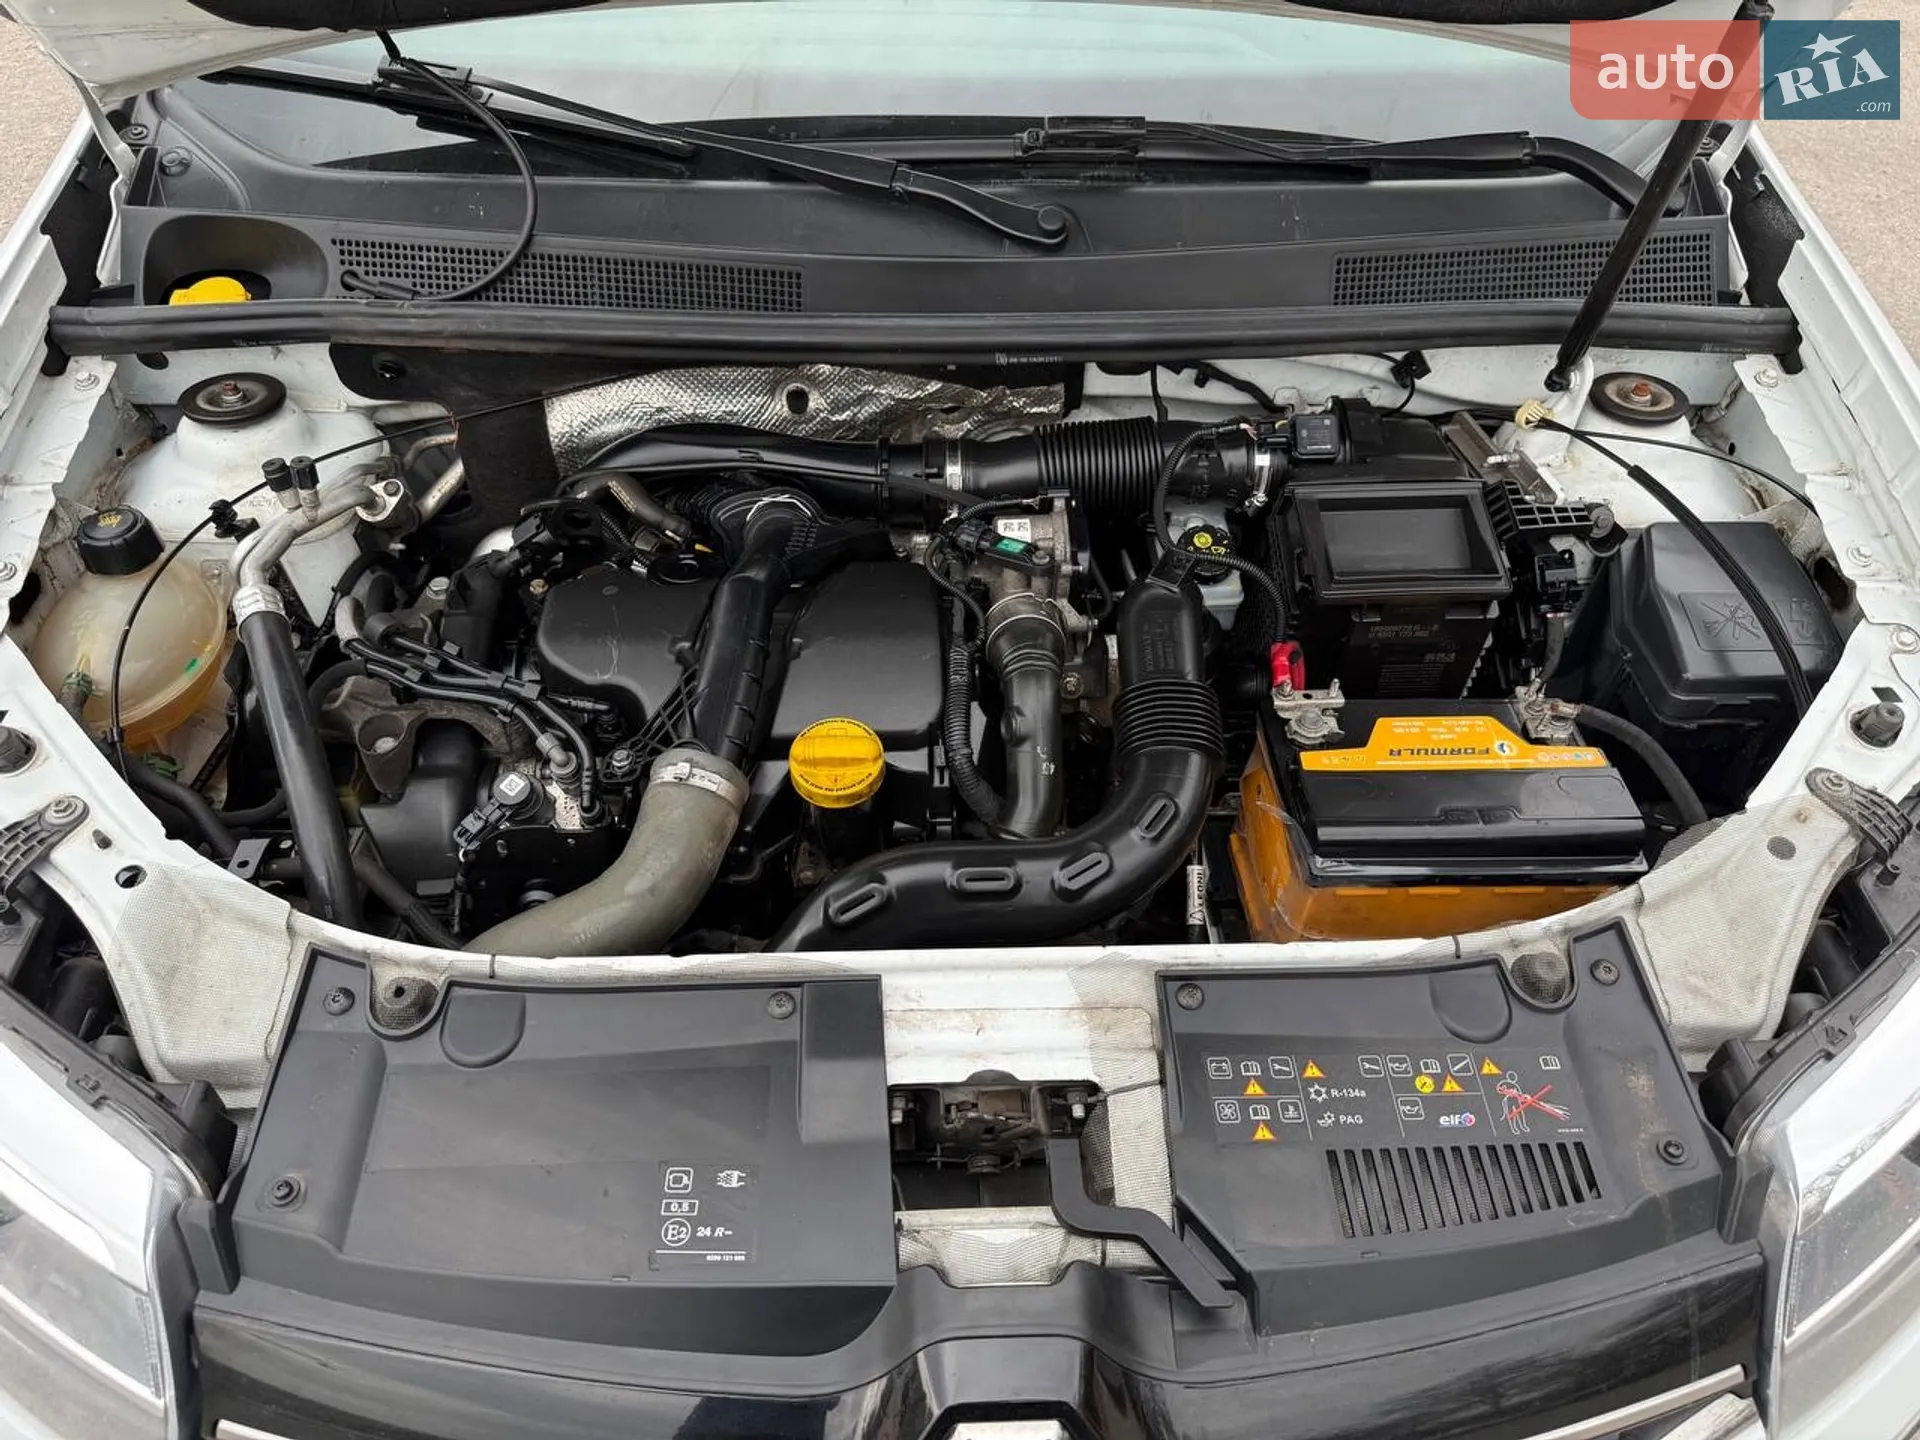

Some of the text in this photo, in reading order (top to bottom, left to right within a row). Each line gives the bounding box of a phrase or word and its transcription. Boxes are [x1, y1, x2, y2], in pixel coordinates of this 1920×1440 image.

[1389, 747, 1491, 757] FORMULA
[1331, 1088, 1367, 1098] R-134a
[1339, 1114, 1364, 1125] PAG
[670, 1202, 690, 1214] 0,5
[666, 1224, 687, 1241] E2
[696, 1226, 712, 1237] 24
